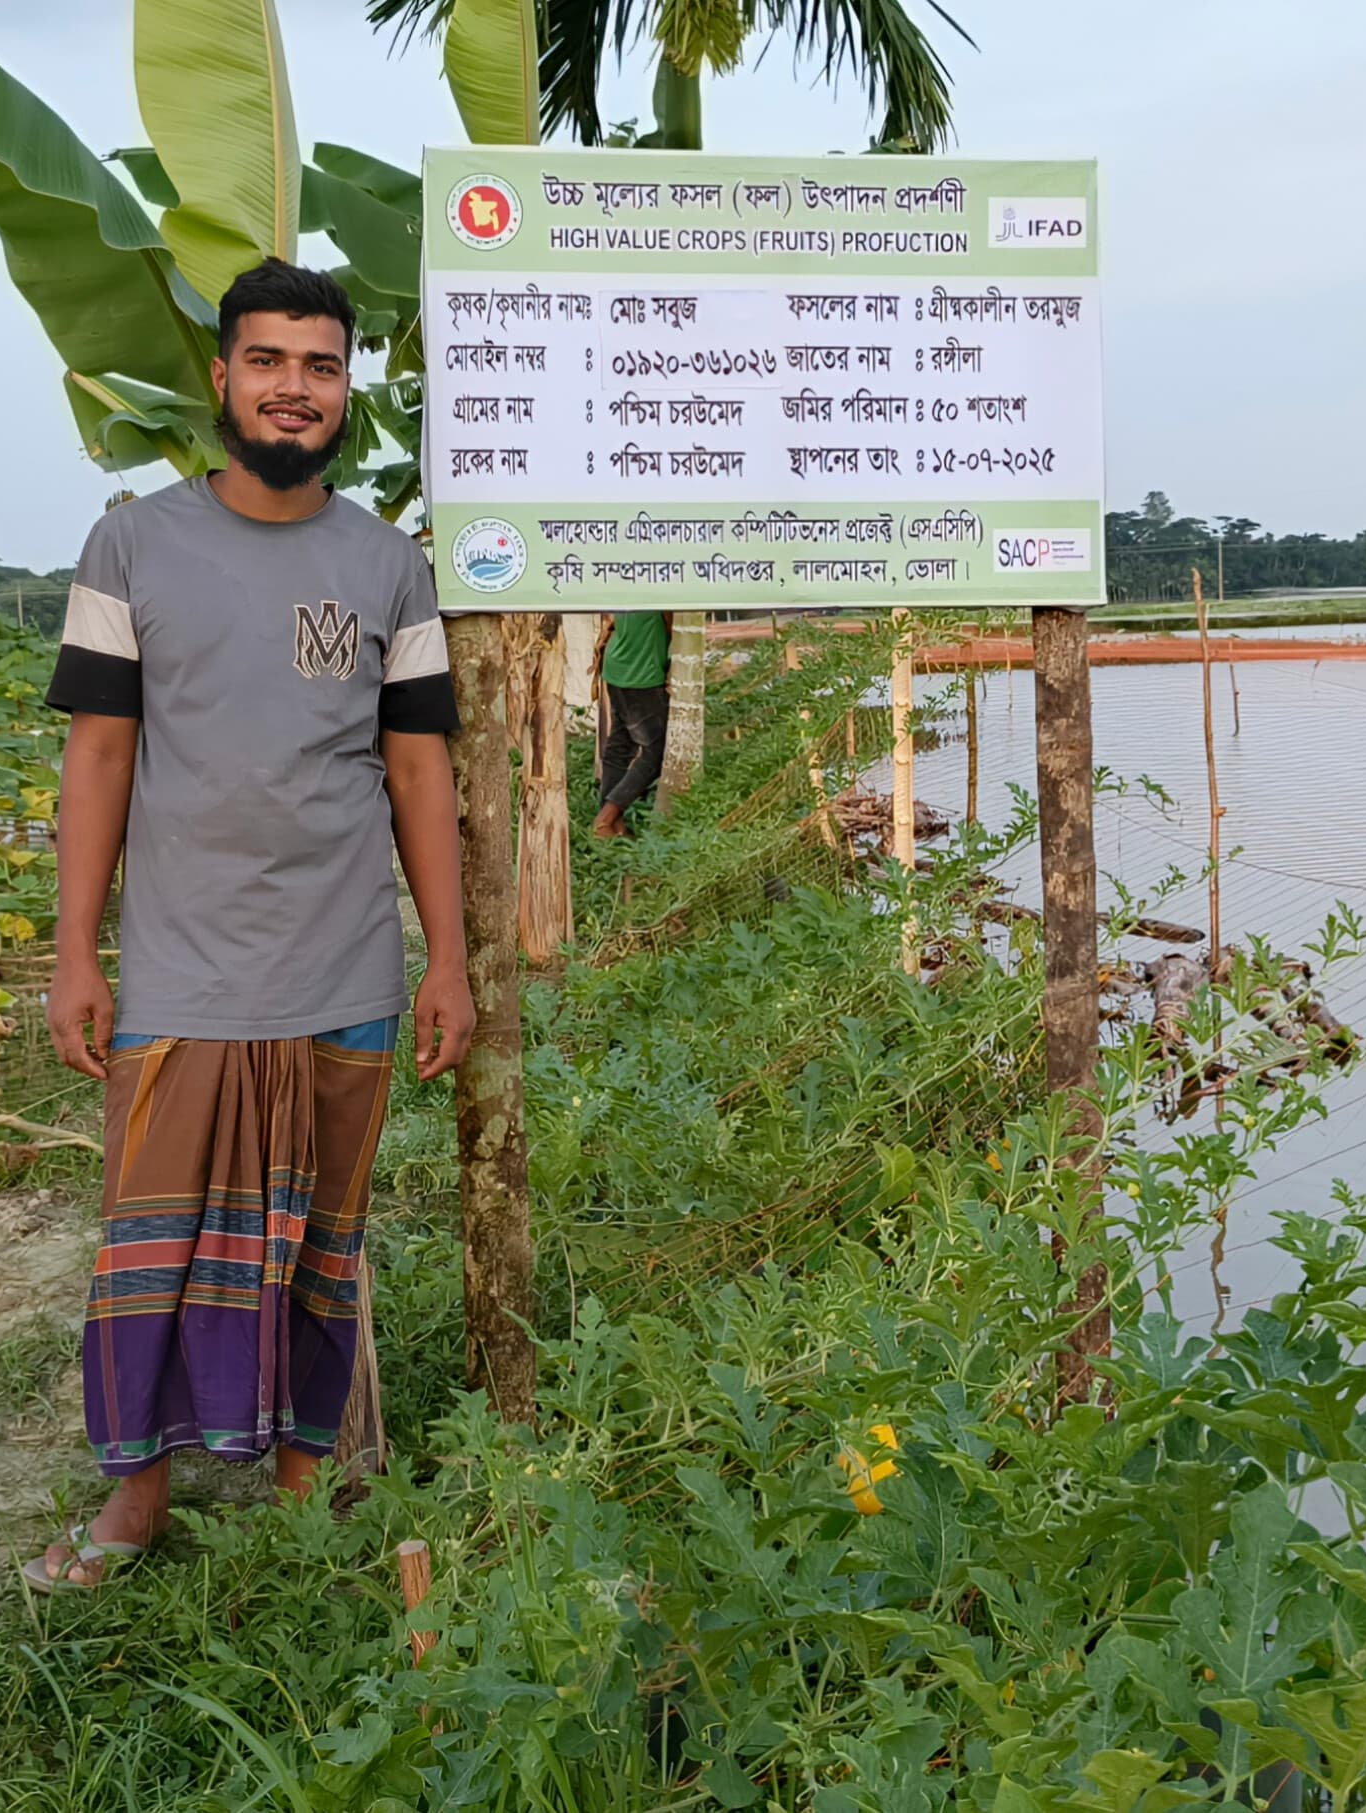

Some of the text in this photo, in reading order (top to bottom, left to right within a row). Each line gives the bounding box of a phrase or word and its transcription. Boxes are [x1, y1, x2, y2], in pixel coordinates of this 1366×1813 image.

[542, 172, 586, 206] উচ্চ
[593, 182, 660, 217] মূল্যের
[668, 184, 723, 209] ফসল
[802, 177, 887, 213] উৎপাদন
[550, 228, 967, 256] HIGH VALUE CROPS (FRUITS) PROFUCTION
[1028, 219, 1083, 237] IFAD
[651, 296, 698, 331] সবুজ
[786, 294, 858, 322] ফসলের
[864, 293, 900, 322] নাম
[1023, 295, 1082, 329] তরমুজ
[446, 335, 508, 372] মোবাইল
[513, 345, 547, 372] নম্বর
[612, 349, 777, 380] ০১৯২০-৩৬১০২৬
[784, 343, 851, 372] জাতের
[855, 344, 892, 373] নাম
[453, 394, 500, 425] গ্রামের
[505, 395, 535, 424] নাম
[609, 390, 662, 427] পশ্চিম
[667, 391, 745, 427] চরউমেদ
[781, 387, 834, 423] জমির
[841, 387, 909, 423] পরিমান
[932, 398, 958, 422] ৫০
[966, 395, 1027, 424] শতাংশ
[450, 449, 494, 478] ব্লকের
[499, 447, 528, 475] নাম
[610, 442, 662, 477] পশ্চিম
[668, 442, 746, 477] চরউমেদ
[787, 445, 860, 480] স্থাপনের
[866, 445, 902, 475] তাং
[932, 447, 1055, 476] ১৫-০৭-২০২৫
[900, 509, 983, 549] (এসএসিপি)
[998, 538, 1050, 567] SACP
[545, 553, 585, 594] কৃষি
[592, 560, 685, 584] সম্প্রসারণ
